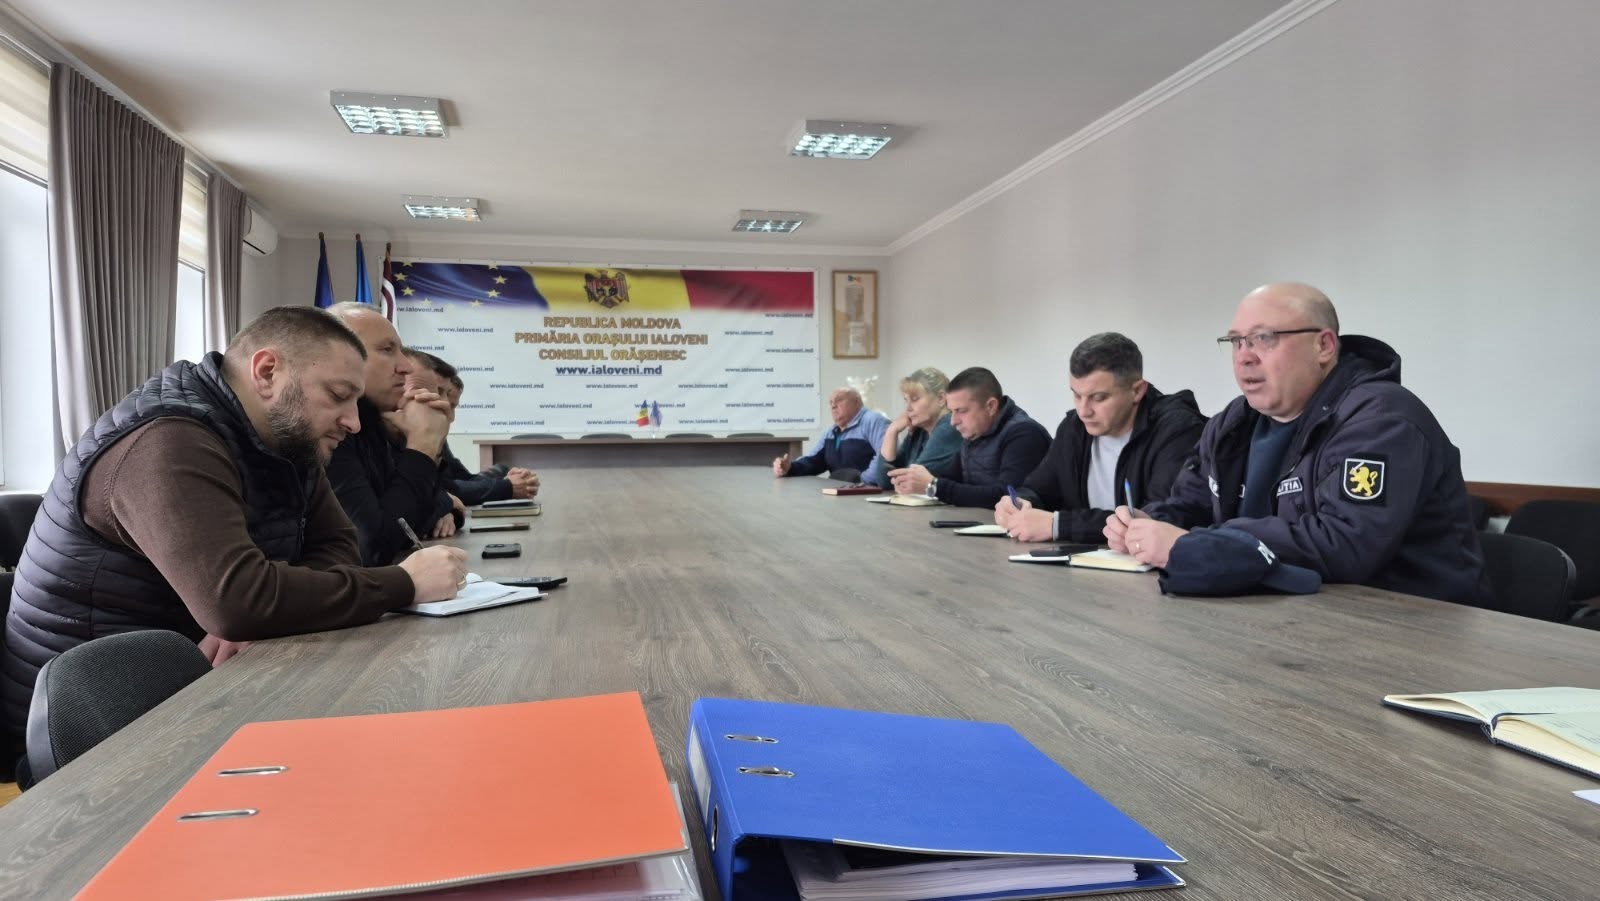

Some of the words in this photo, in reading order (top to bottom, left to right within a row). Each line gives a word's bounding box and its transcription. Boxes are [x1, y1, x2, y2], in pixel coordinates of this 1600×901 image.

[543, 316, 617, 329] REPUBLICA
[621, 317, 681, 330] MOLDOVA
[515, 330, 580, 345] PRIMĂRIA
[582, 332, 648, 347] ORAȘULUI
[650, 334, 708, 345] IALOVENI
[538, 349, 609, 361] CONSILIUL
[610, 347, 687, 363] ORĂȘENESC
[556, 364, 663, 376] www.ialoveni.md
